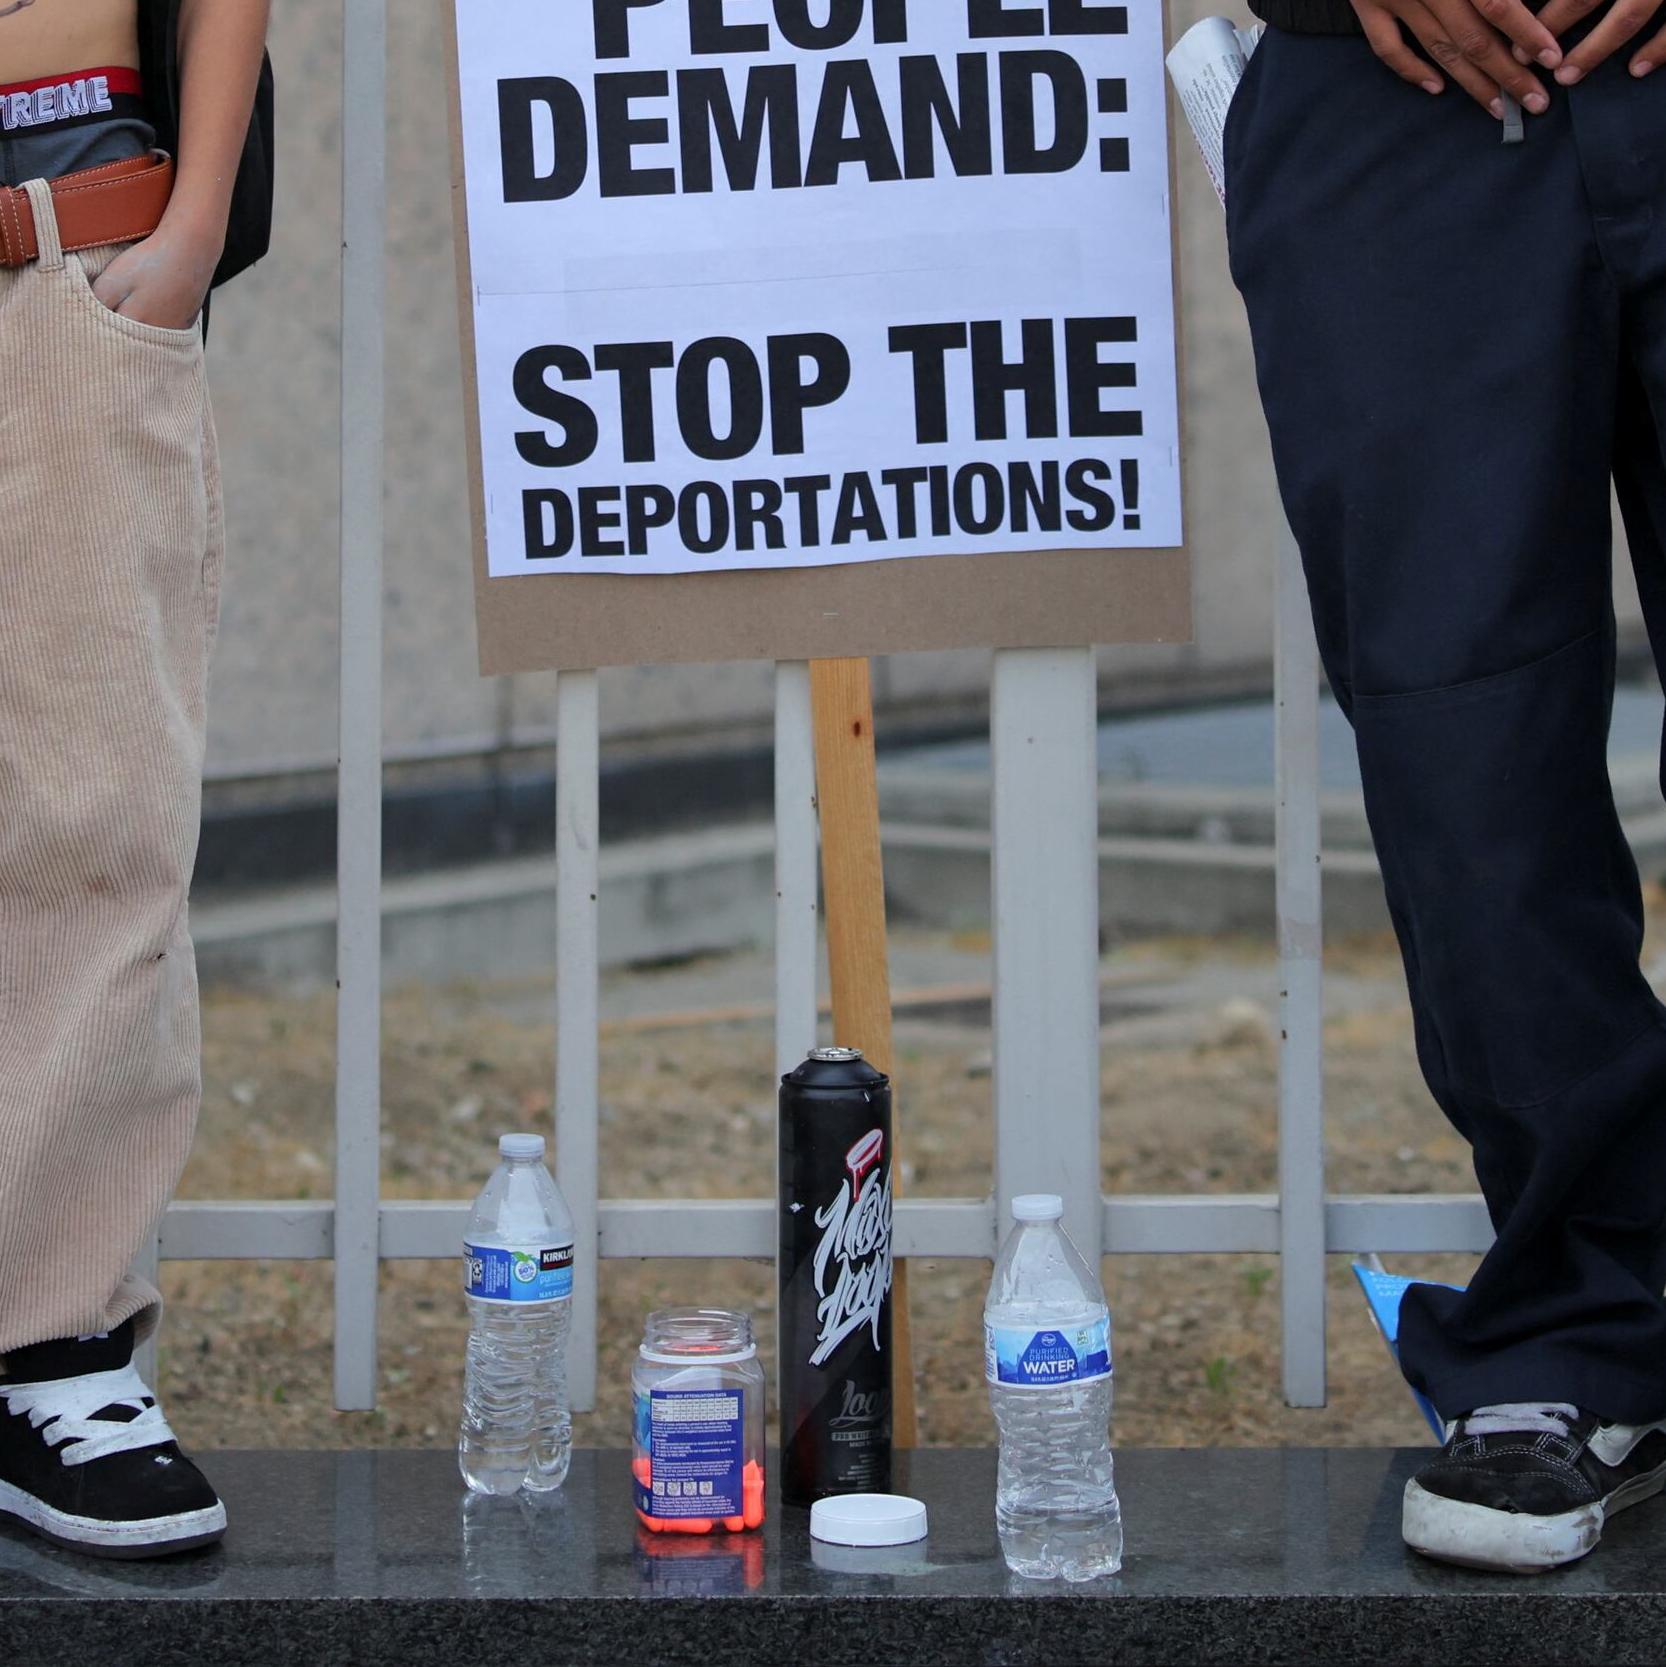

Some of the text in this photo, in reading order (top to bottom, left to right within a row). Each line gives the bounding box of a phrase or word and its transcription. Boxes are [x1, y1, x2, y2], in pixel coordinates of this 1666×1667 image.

[497, 49, 1130, 203] DEMAND:
[512, 316, 1143, 467] STOP THE
[522, 458, 1141, 559] DEPORTATIONS!
[1023, 1359, 1075, 1374] WATER
